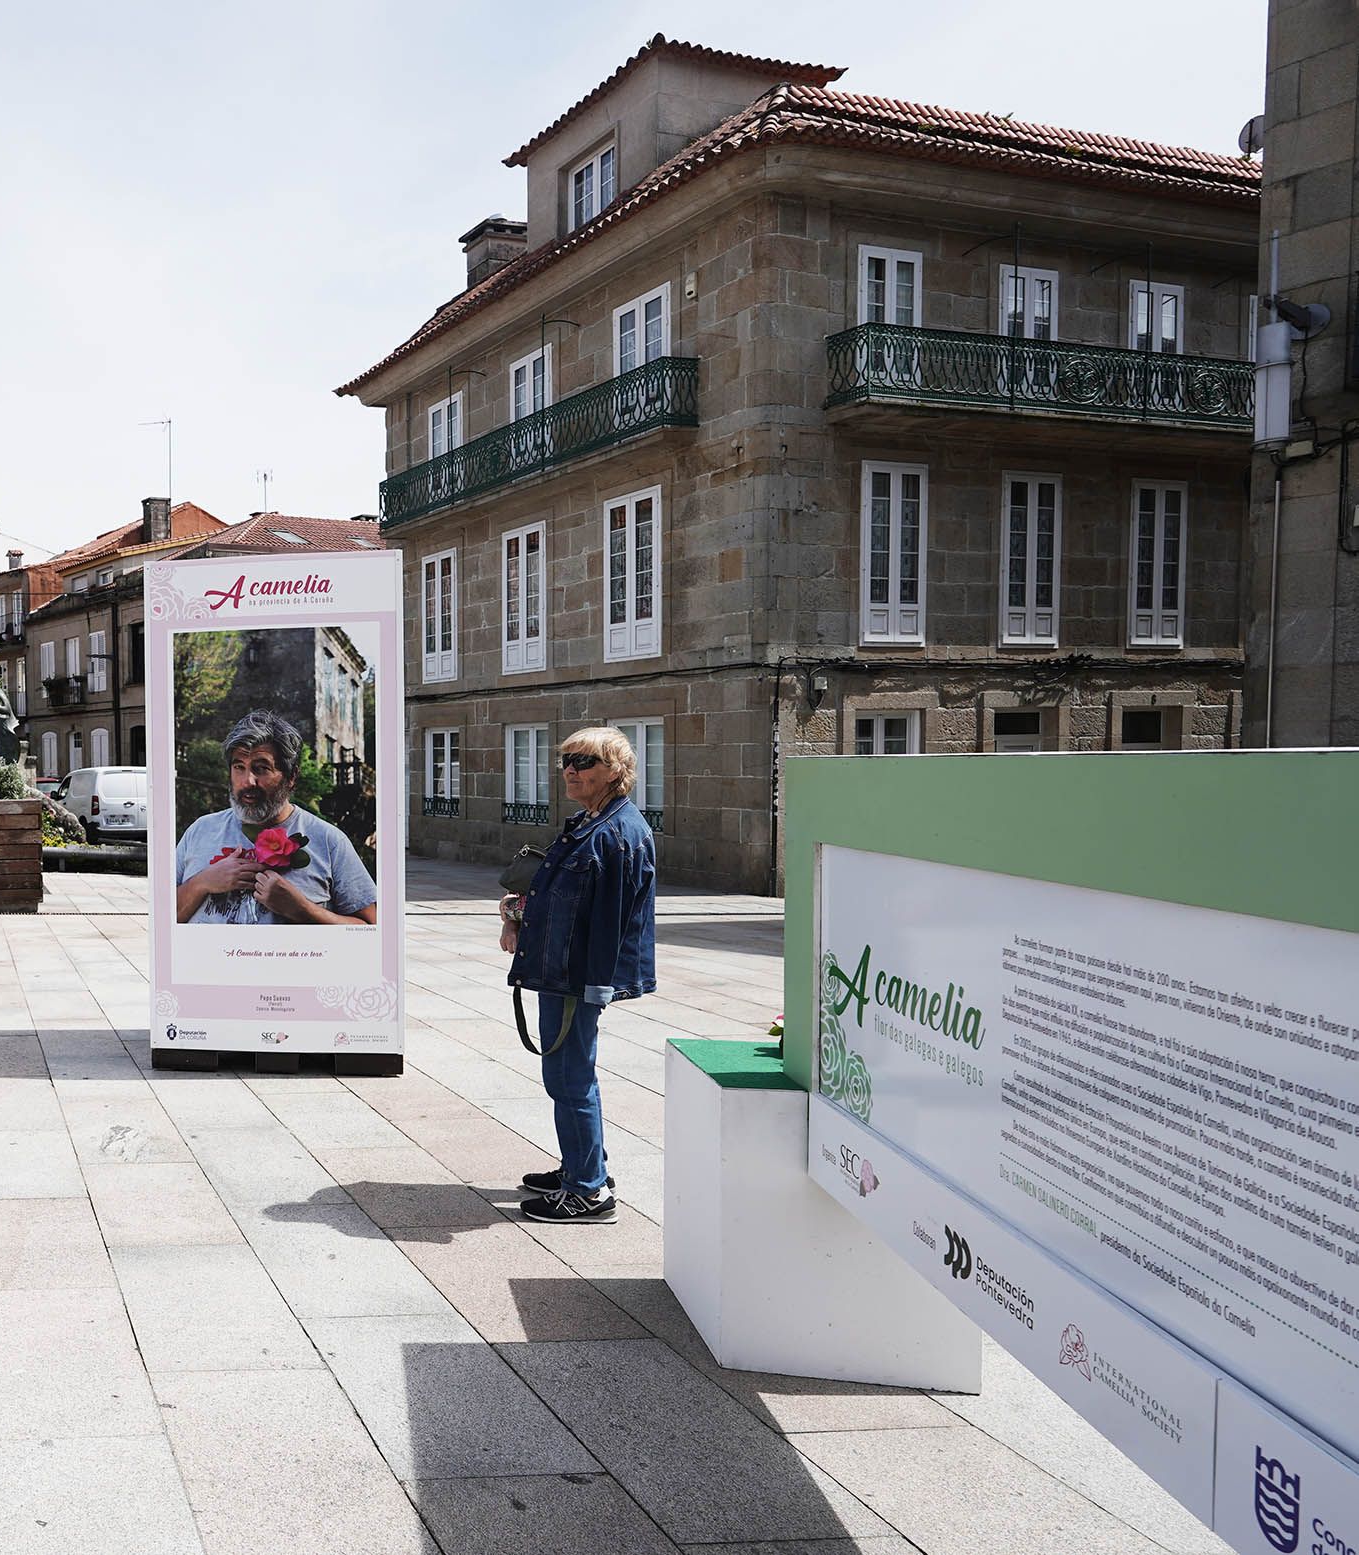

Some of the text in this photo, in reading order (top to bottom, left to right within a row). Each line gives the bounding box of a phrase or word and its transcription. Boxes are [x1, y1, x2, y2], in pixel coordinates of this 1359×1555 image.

[204, 574, 333, 610] A camelia
[259, 599, 290, 607] provincia
[310, 596, 334, 604] Coruña
[828, 944, 986, 1050] A camelia
[1156, 974, 1348, 1037] 200 Estamos crecer florecer
[1206, 1006, 1272, 1036] de Oriente, de onde
[874, 1014, 984, 1086] flor das galegas e galegos
[1180, 1060, 1296, 1117] Concurso Internacional Camelia,
[1198, 1050, 1338, 1108] adaptación que conquistou
[1137, 1086, 1352, 1188] Sociedade Española Camelia, organización sen ánimo de
[1189, 1082, 1337, 1150] de Vigo, Pontevedra Vilagarcía de Arousa.
[840, 1144, 860, 1180] SEC
[1263, 1163, 1291, 1182] camelia
[1201, 1195, 1226, 1218] Europa.
[1206, 1161, 1320, 1226] Turismo de Galicia Sociedade
[1011, 1172, 1036, 1199] CARMEN
[1037, 1188, 1069, 1219] SALINERO
[1141, 1254, 1176, 1287] Sociedade
[1178, 1276, 1209, 1308] Española
[1223, 1305, 1255, 1338] Camelia
[1286, 1219, 1310, 1241] tamén
[1312, 1232, 1335, 1254] teñen
[976, 1256, 1034, 1312] Deputación
[976, 1273, 1034, 1330] Pontevedra
[1256, 1256, 1278, 1274] naceu
[1289, 1272, 1326, 1301] obxectivo
[1328, 1291, 1339, 1308] de
[1340, 1298, 1354, 1316] dar
[1262, 1279, 1338, 1329] apaixonante mundo
[1092, 1366, 1182, 1444] CAMELLIA SOCIETY
[1094, 1352, 1182, 1430] INTERNATIONAL
